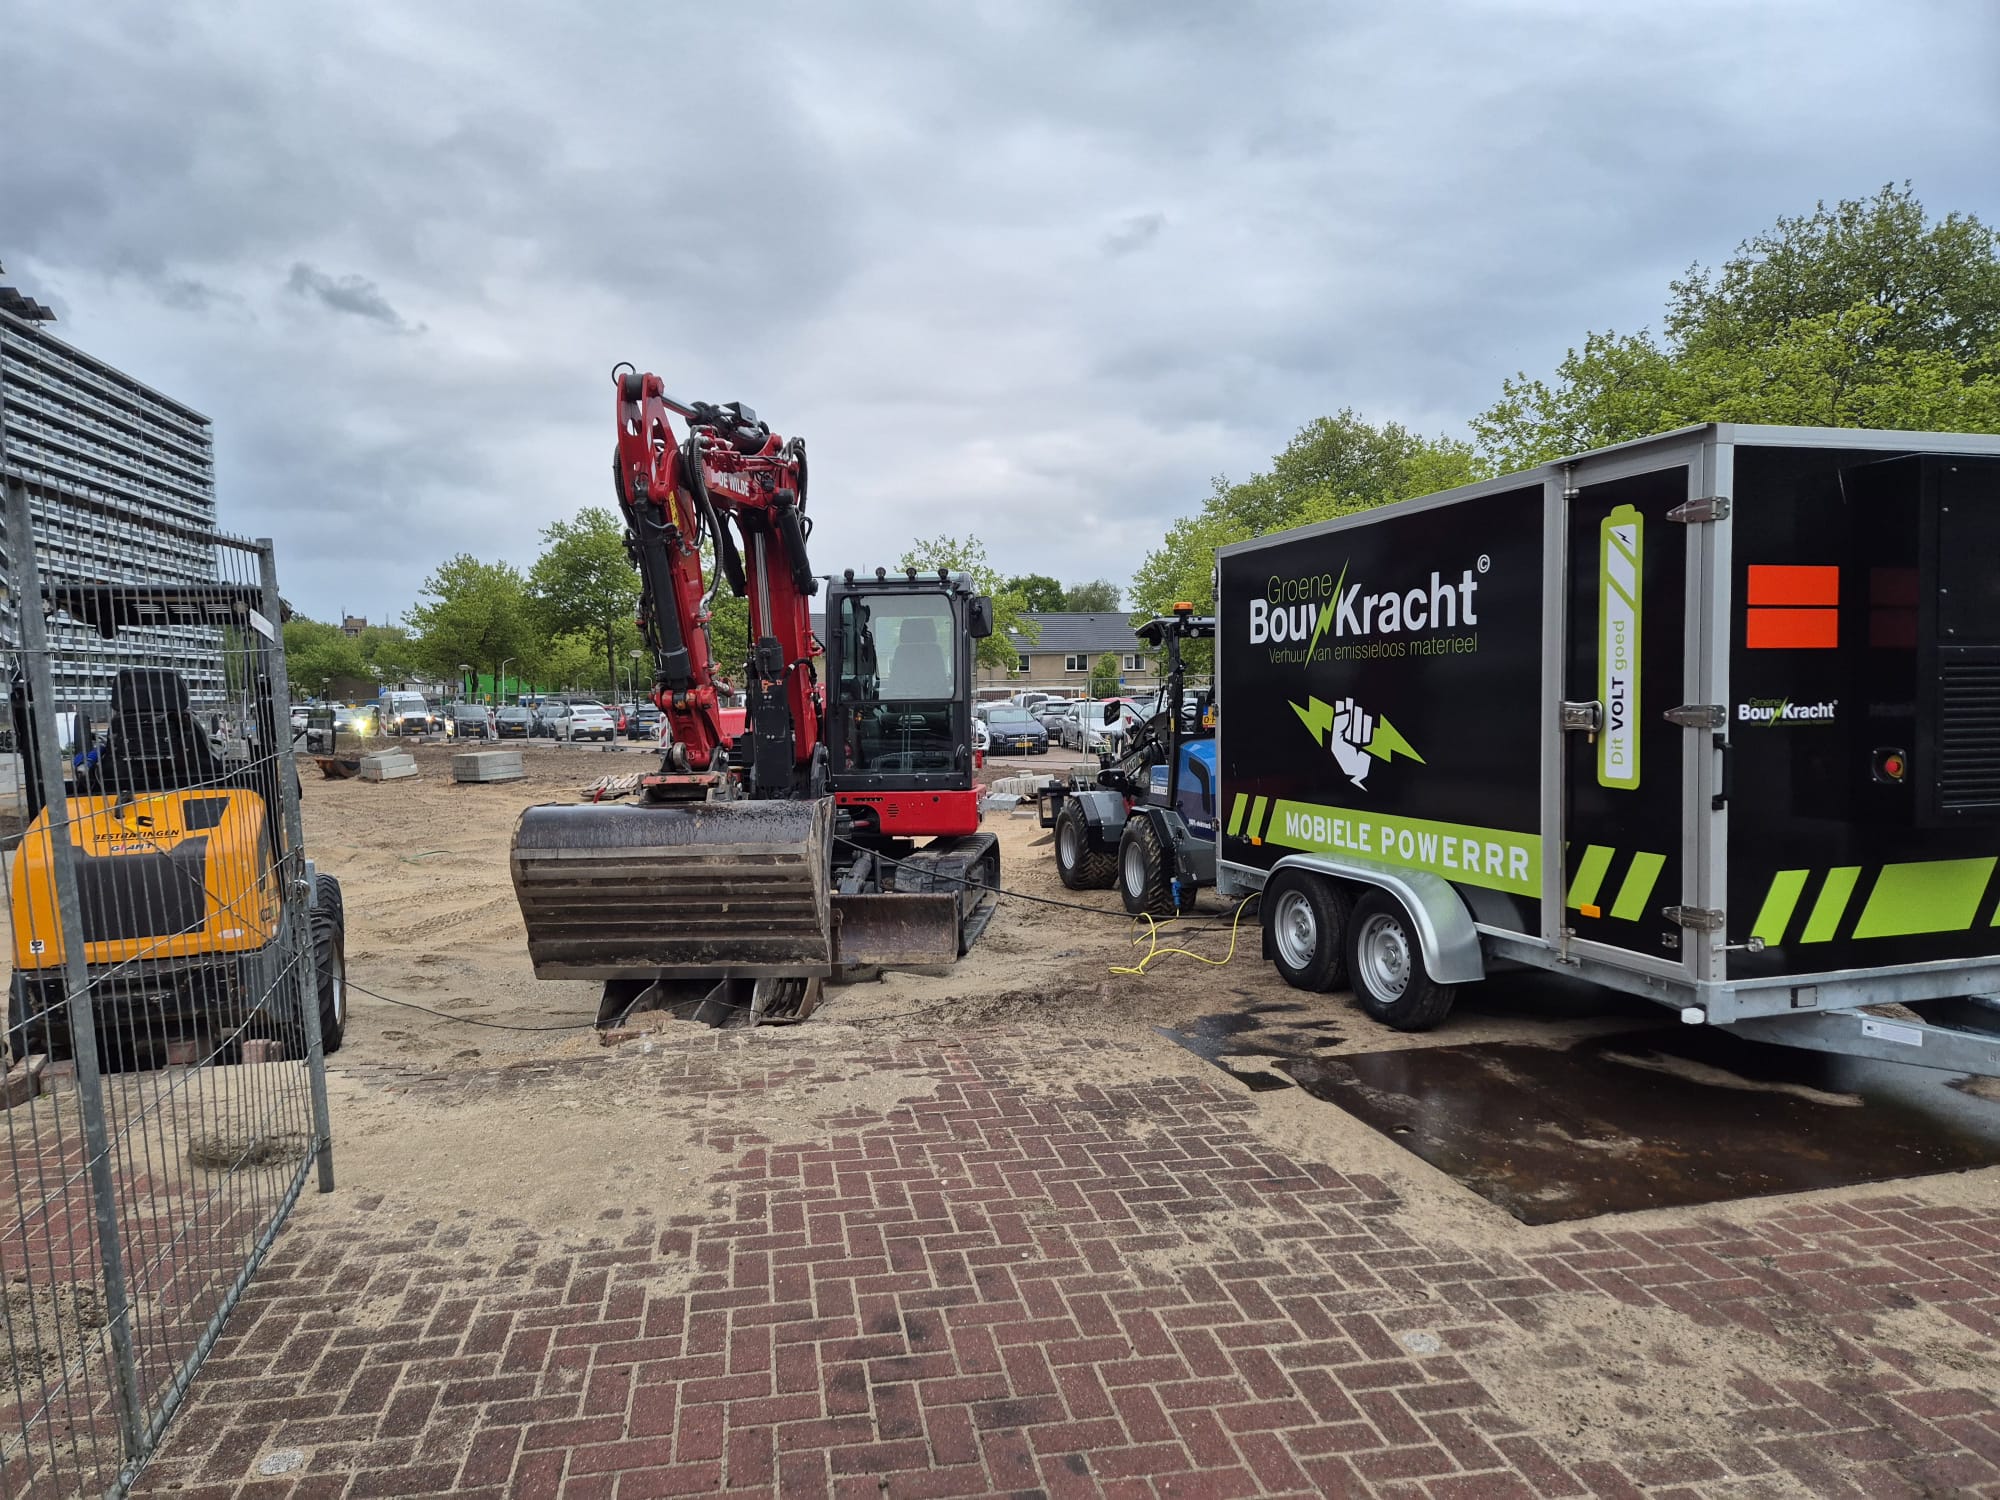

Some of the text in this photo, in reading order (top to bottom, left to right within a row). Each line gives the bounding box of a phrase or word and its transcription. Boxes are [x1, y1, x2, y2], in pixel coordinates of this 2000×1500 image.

[729, 475, 750, 497] WILDE
[1267, 573, 1333, 605] Groene
[1268, 631, 1478, 665] Verhuur van emissieloos materieel
[1610, 620, 1628, 765] Dit VOLT goed
[1285, 810, 1529, 881] MOBIELE POWERRR
